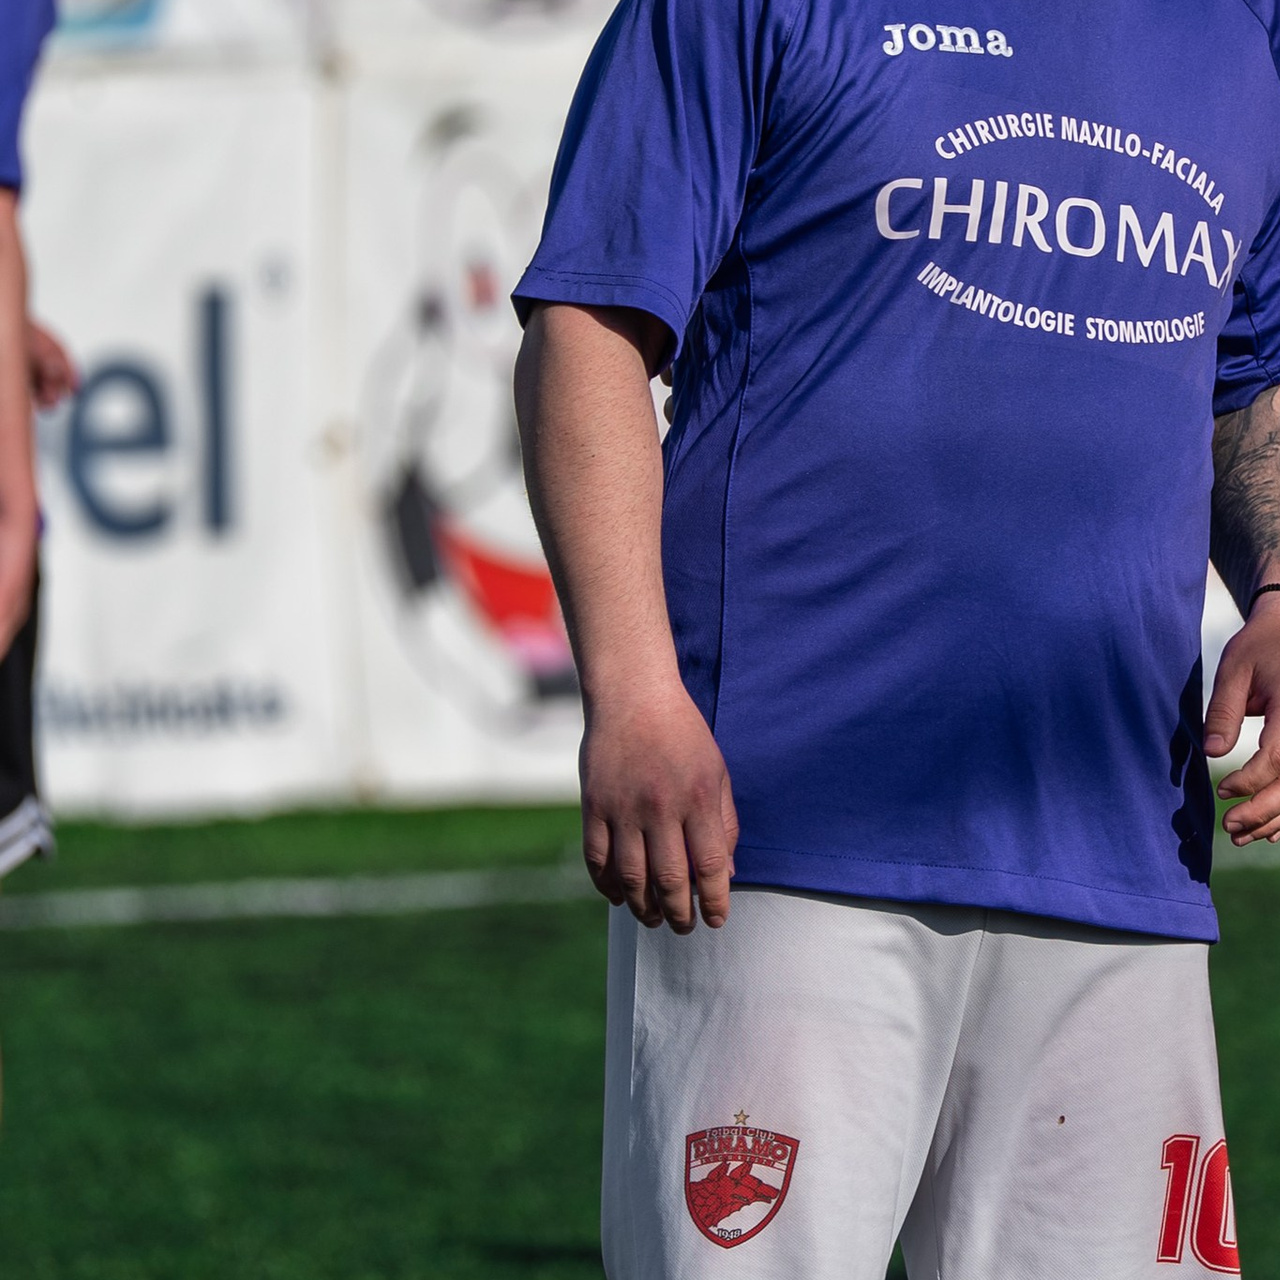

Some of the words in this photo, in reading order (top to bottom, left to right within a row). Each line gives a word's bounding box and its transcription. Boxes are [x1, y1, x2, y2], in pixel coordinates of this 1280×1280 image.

[934, 112, 1056, 160] CHIRURGIE
[1060, 116, 1226, 216] MAXILO-FACIALA
[874, 177, 1243, 297] CHIROMAX
[916, 262, 1076, 336] IMPLANTOLOGIE
[1085, 311, 1205, 344] STOMATOLOGIE
[693, 1135, 789, 1162] DINAMO
[746, 1128, 776, 1141] Club
[717, 1228, 742, 1241] 1948
[1156, 1134, 1241, 1275] 10
